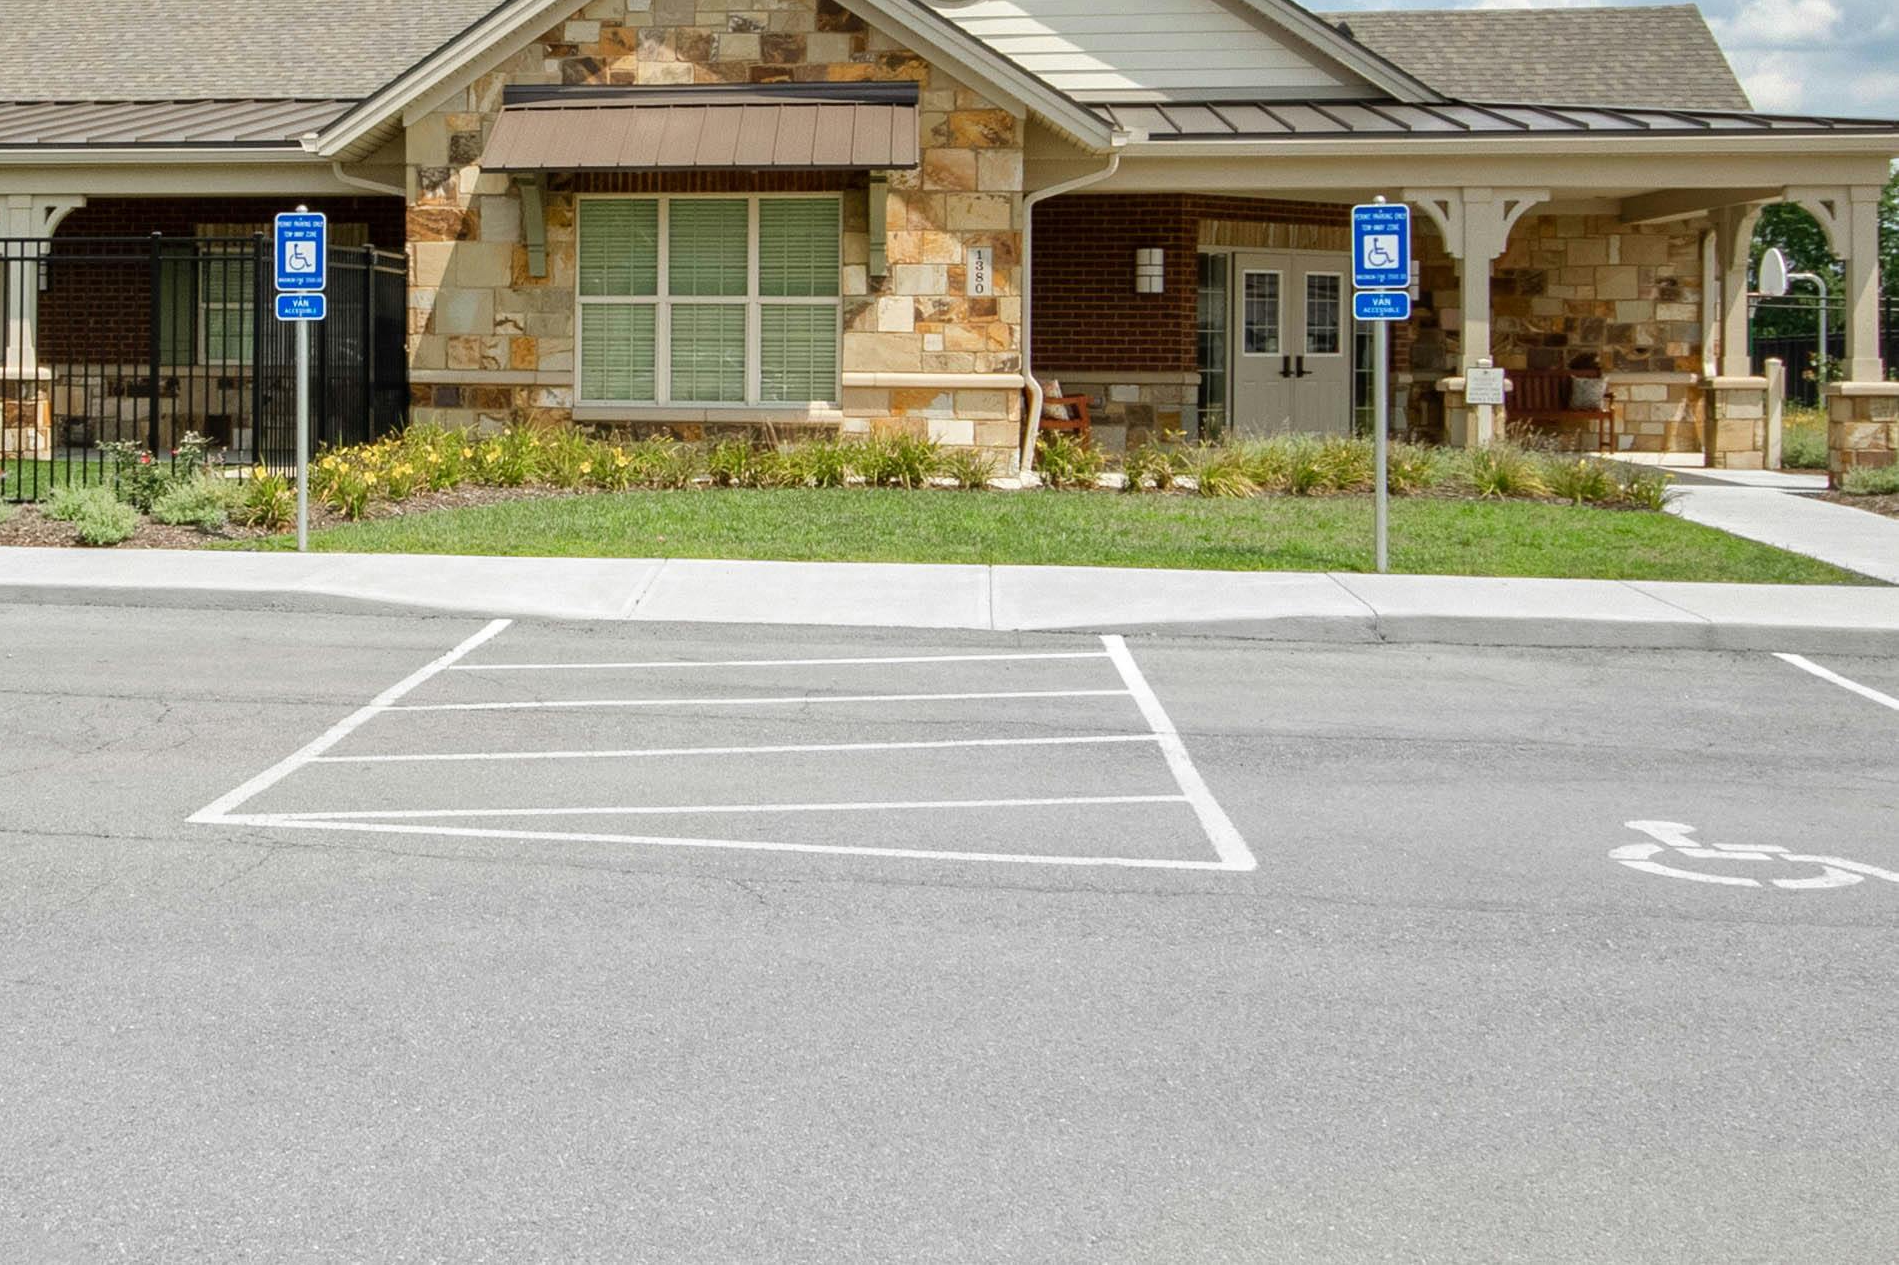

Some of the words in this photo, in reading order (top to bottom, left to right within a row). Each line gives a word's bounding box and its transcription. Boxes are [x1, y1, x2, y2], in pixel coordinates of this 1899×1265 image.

[975, 250, 984, 294] 1380
[292, 299, 309, 307] VAN
[1372, 298, 1391, 306] VAN
